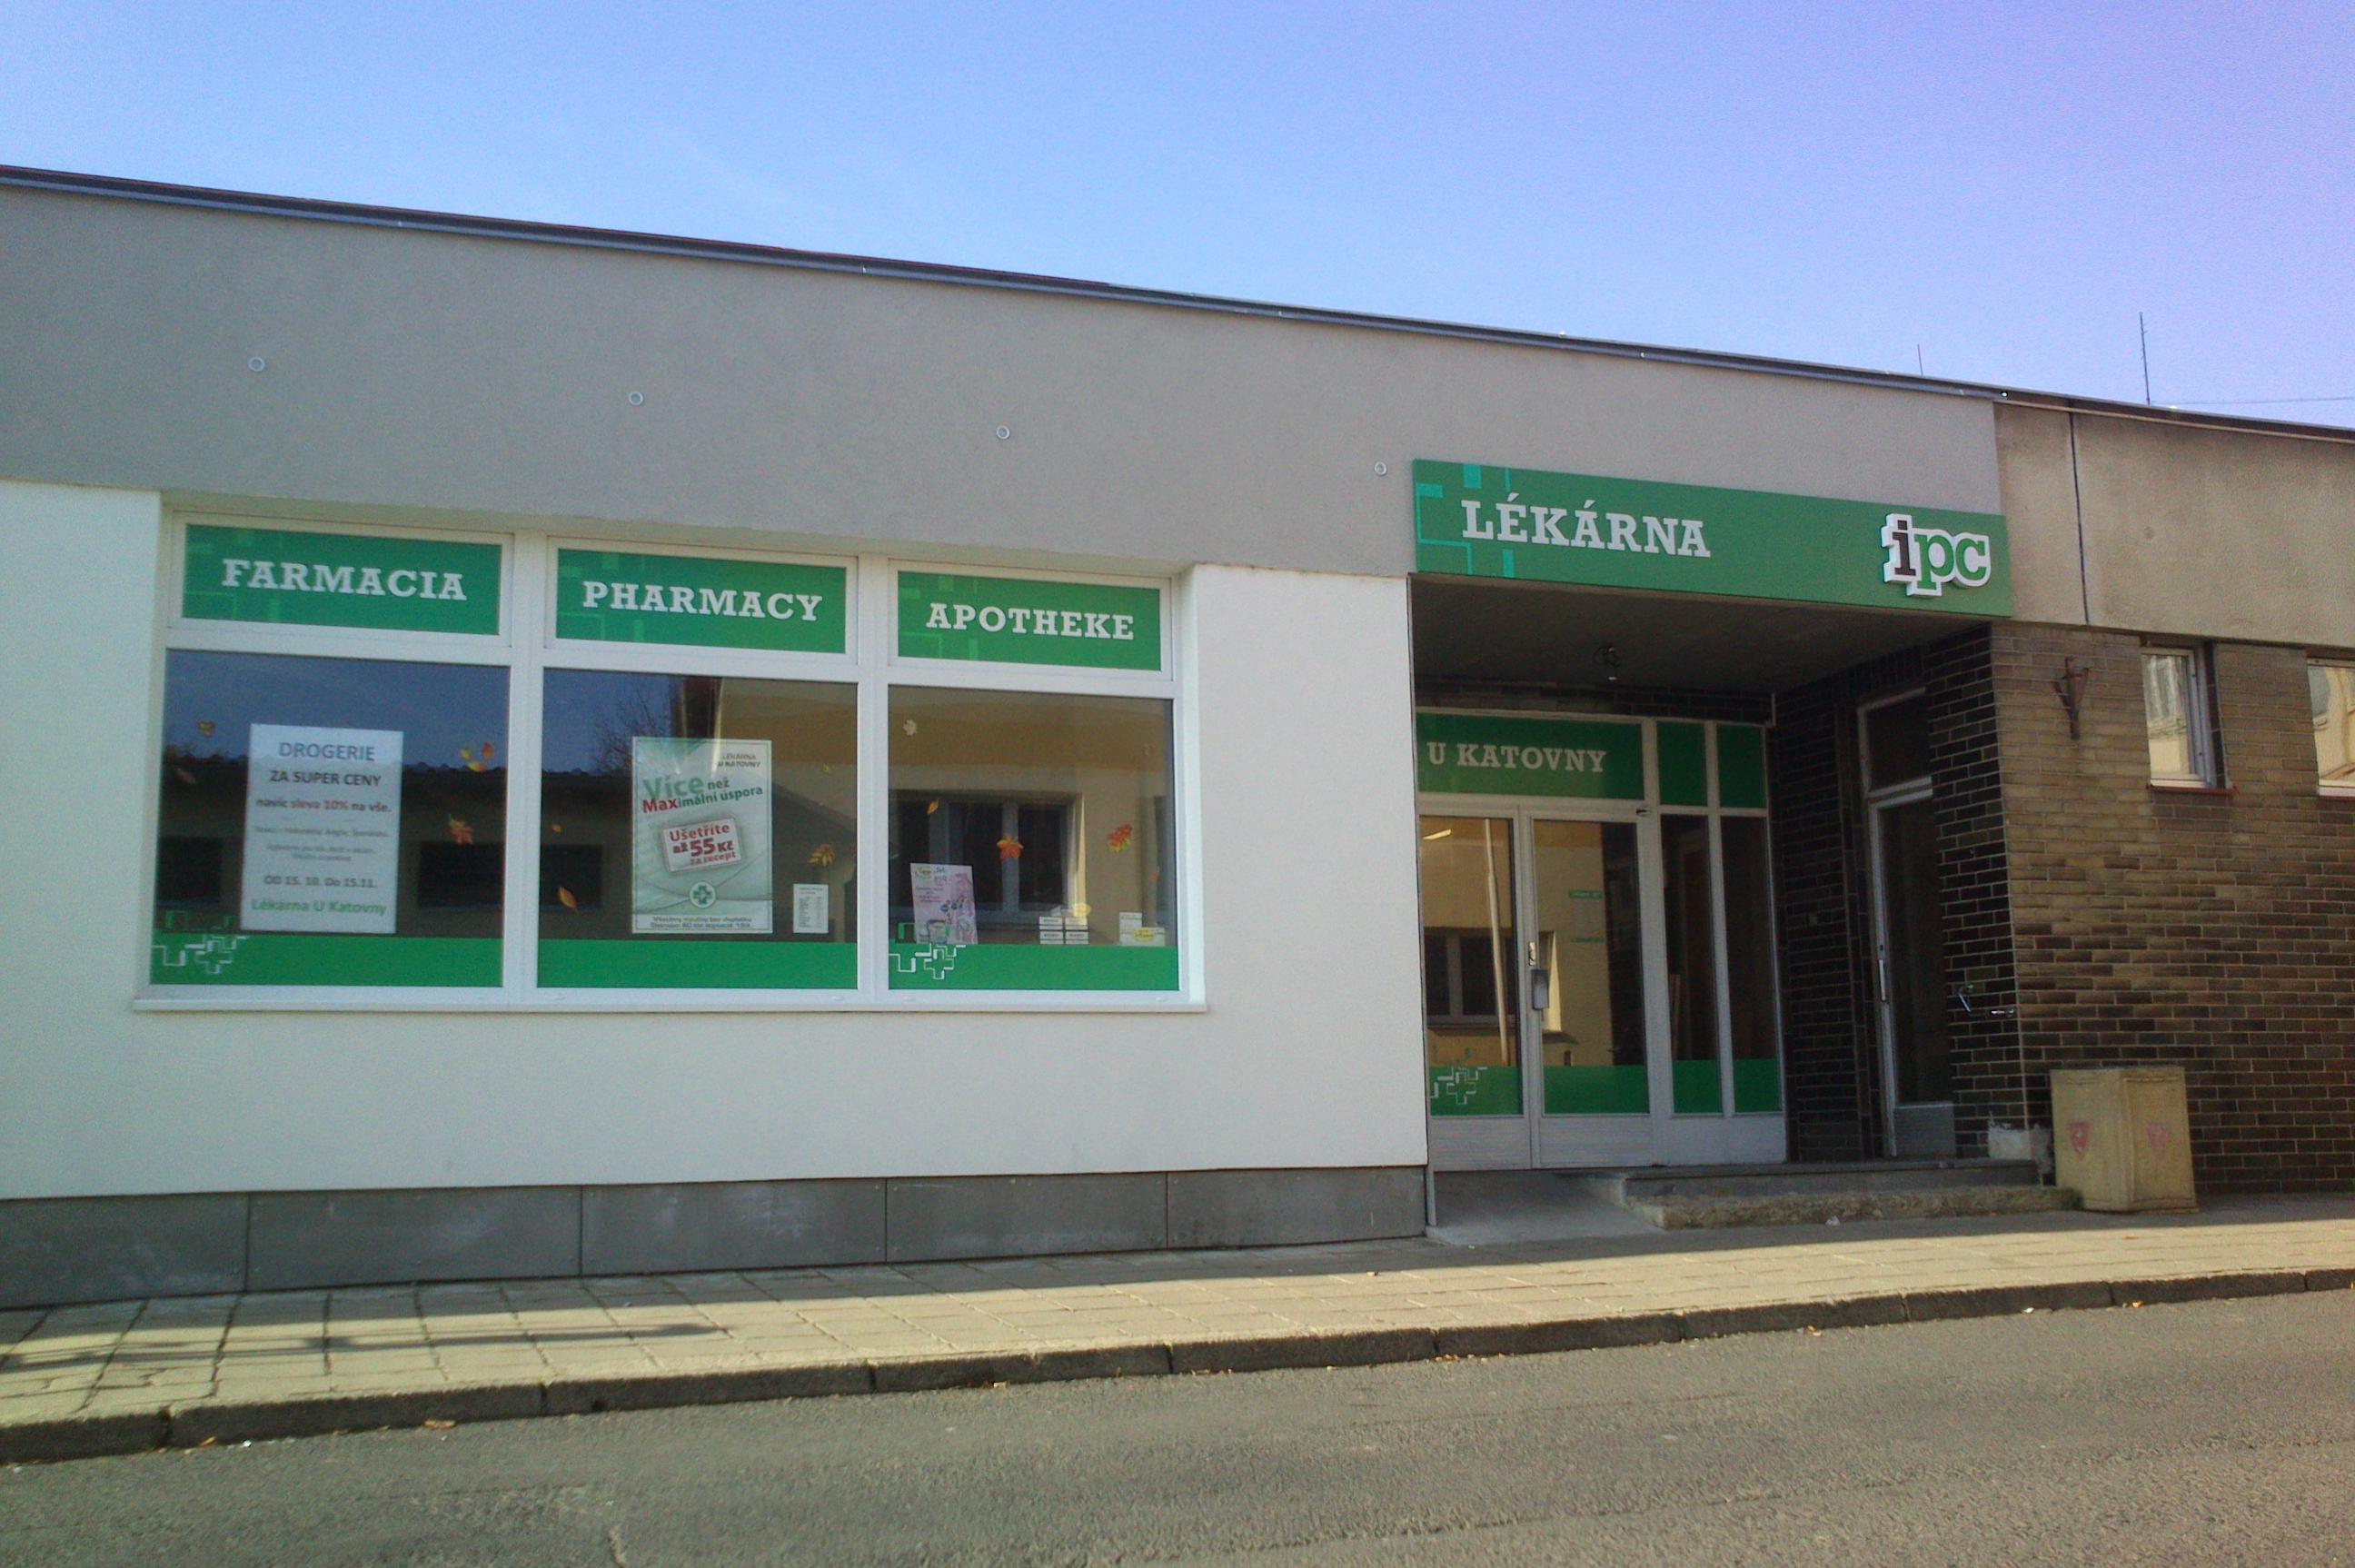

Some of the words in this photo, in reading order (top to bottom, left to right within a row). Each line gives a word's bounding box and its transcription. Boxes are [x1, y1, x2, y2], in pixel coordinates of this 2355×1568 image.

[1461, 492, 1711, 558] LÉKÁRNA
[222, 559, 467, 600] FARMACIA
[582, 581, 822, 621] PHARMACY
[925, 602, 1134, 640] APOTHEKE
[278, 741, 376, 761] DROGERIE
[1426, 741, 1446, 765] U
[1456, 743, 1606, 772] KATOVNY
[269, 769, 289, 782] ZA
[293, 772, 341, 785] SUPER
[343, 773, 382, 786] CENY
[642, 775, 705, 800] Více
[707, 778, 730, 790] než
[642, 790, 718, 814] Maximální
[720, 787, 764, 802] úspora
[691, 838, 716, 857] 55
